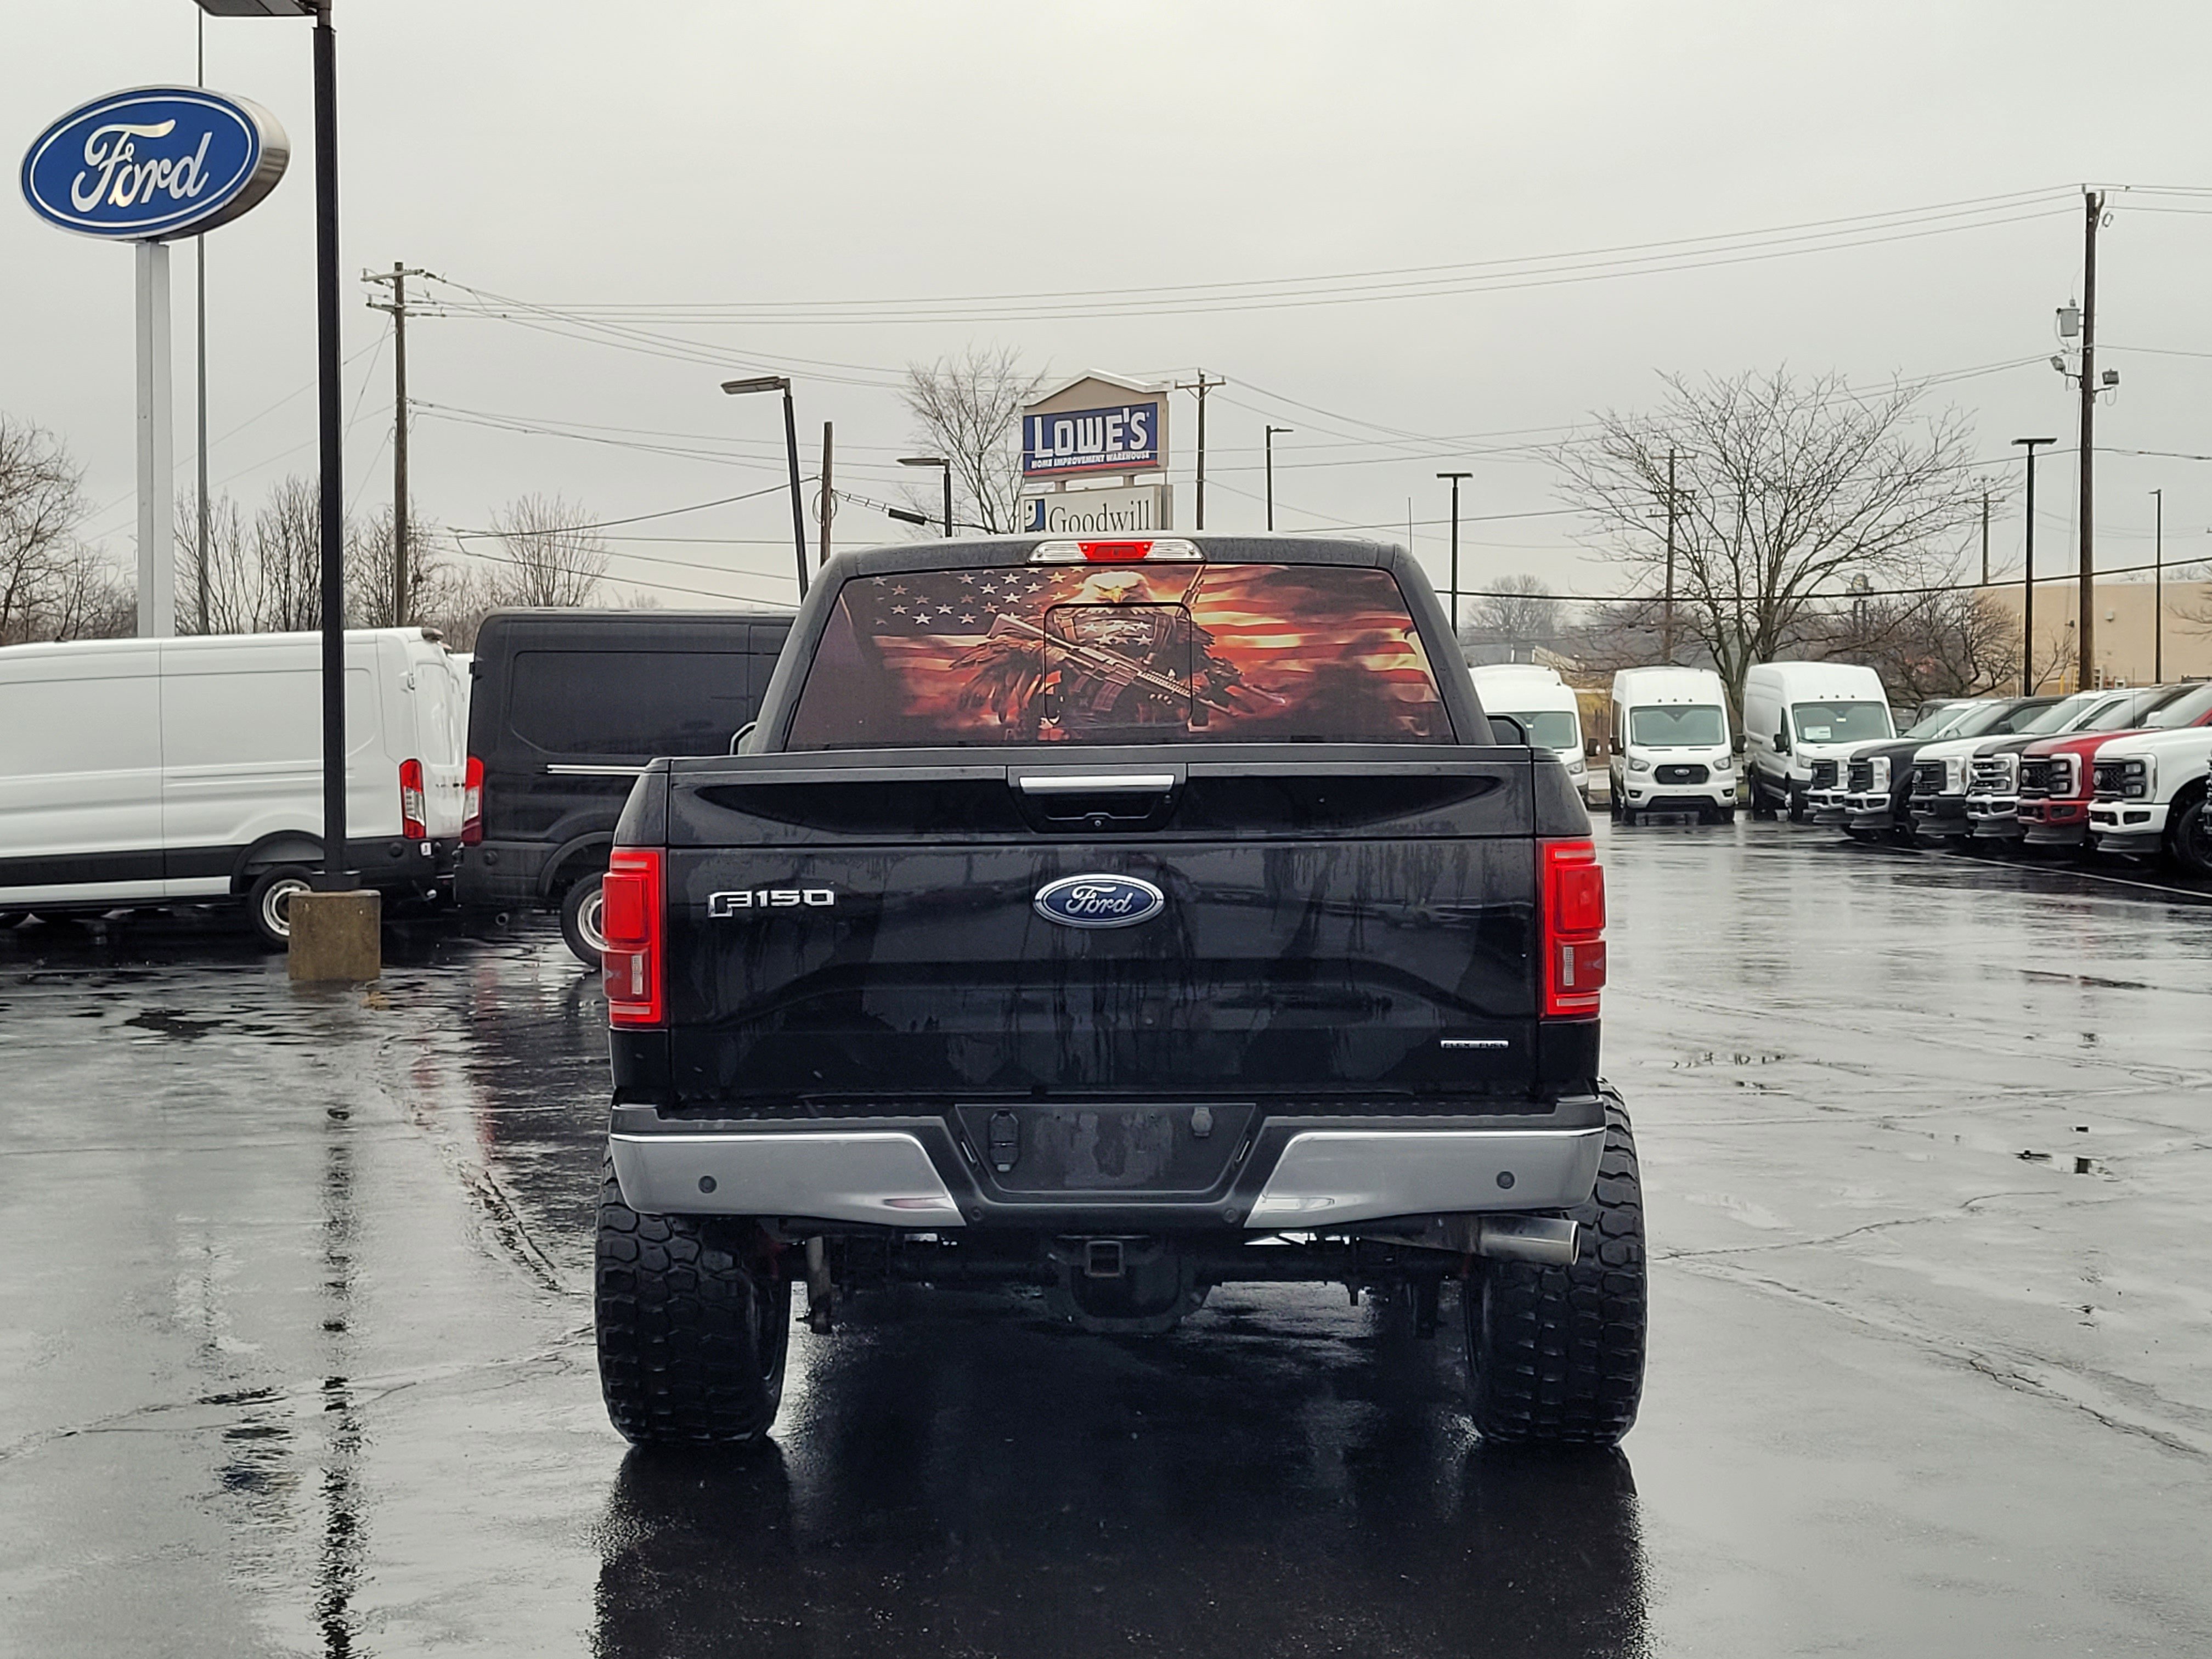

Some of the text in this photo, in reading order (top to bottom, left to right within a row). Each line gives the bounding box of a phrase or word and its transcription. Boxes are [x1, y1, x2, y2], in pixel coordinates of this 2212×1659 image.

[71, 119, 213, 212] Ford
[1034, 407, 1148, 458] LOWE'S
[1031, 450, 1150, 469] HOME IMPROVEMENT WAREHOUSE
[1049, 499, 1150, 533] Goodwill
[1065, 885, 1135, 914] Ford
